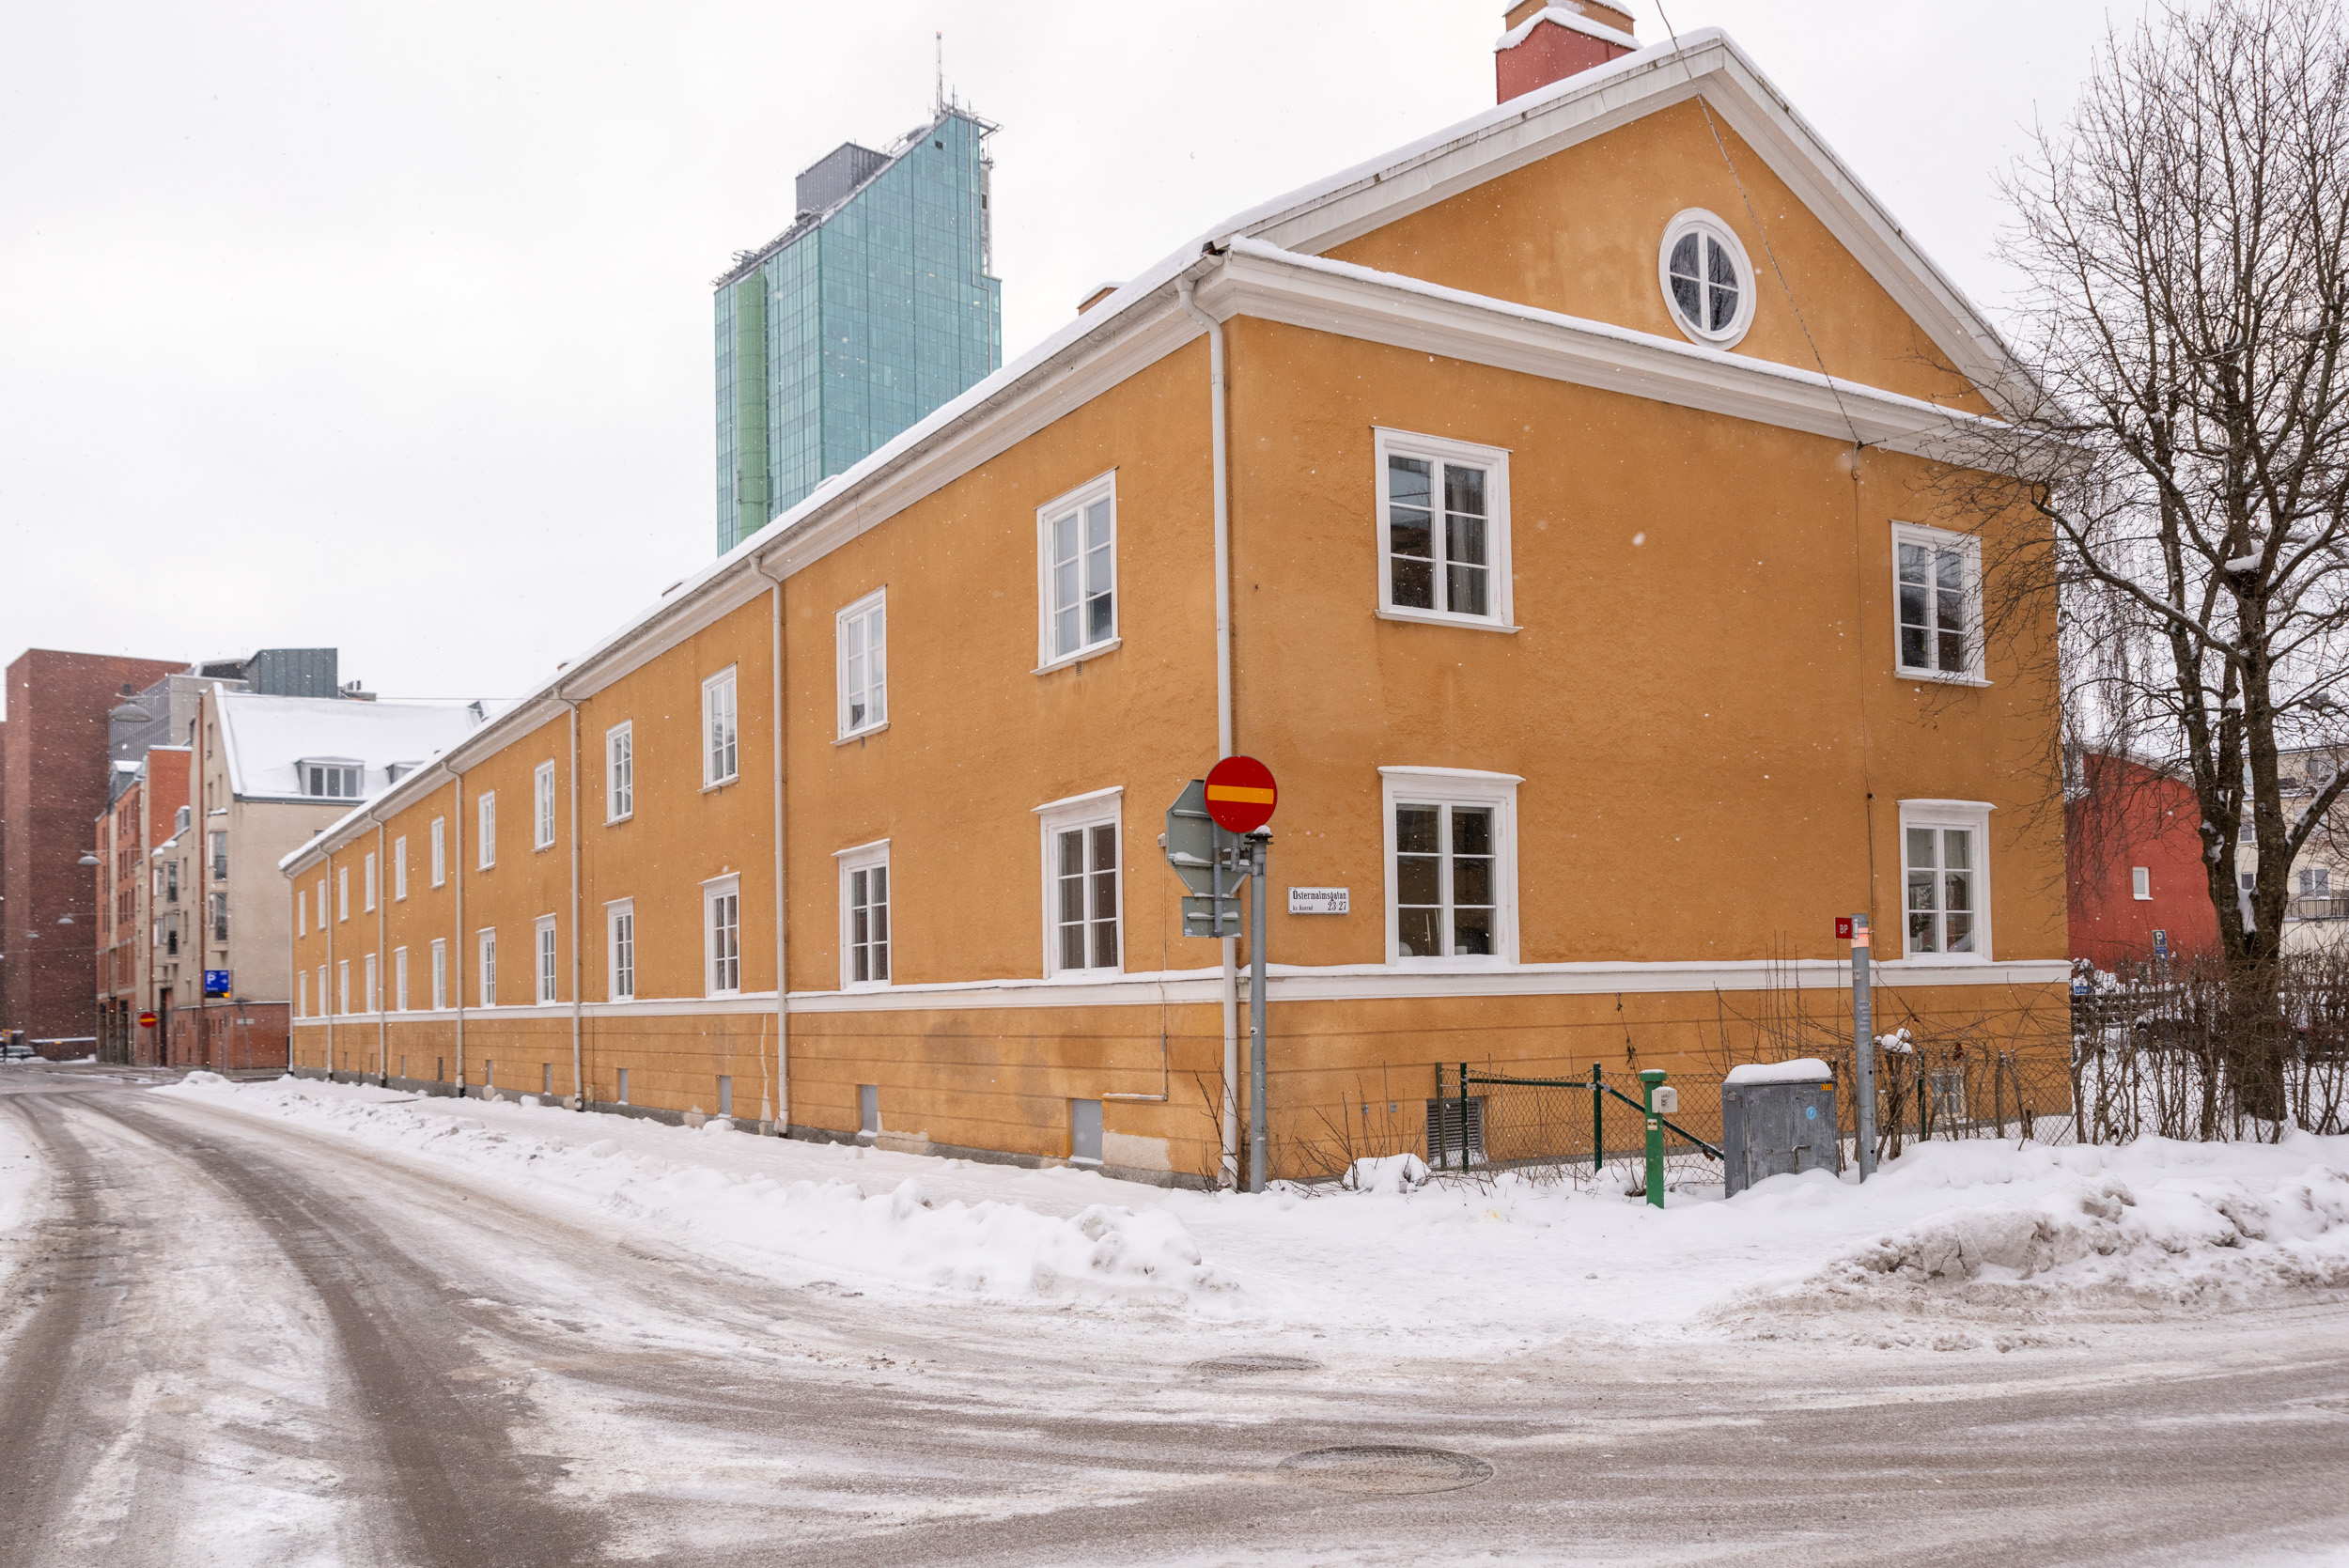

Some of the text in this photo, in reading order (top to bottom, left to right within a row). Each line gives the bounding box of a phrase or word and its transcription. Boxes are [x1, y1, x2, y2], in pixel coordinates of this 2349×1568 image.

[1292, 888, 1346, 902] Östermalmsgatan
[1839, 924, 1849, 935] BP
[206, 974, 216, 985] P
